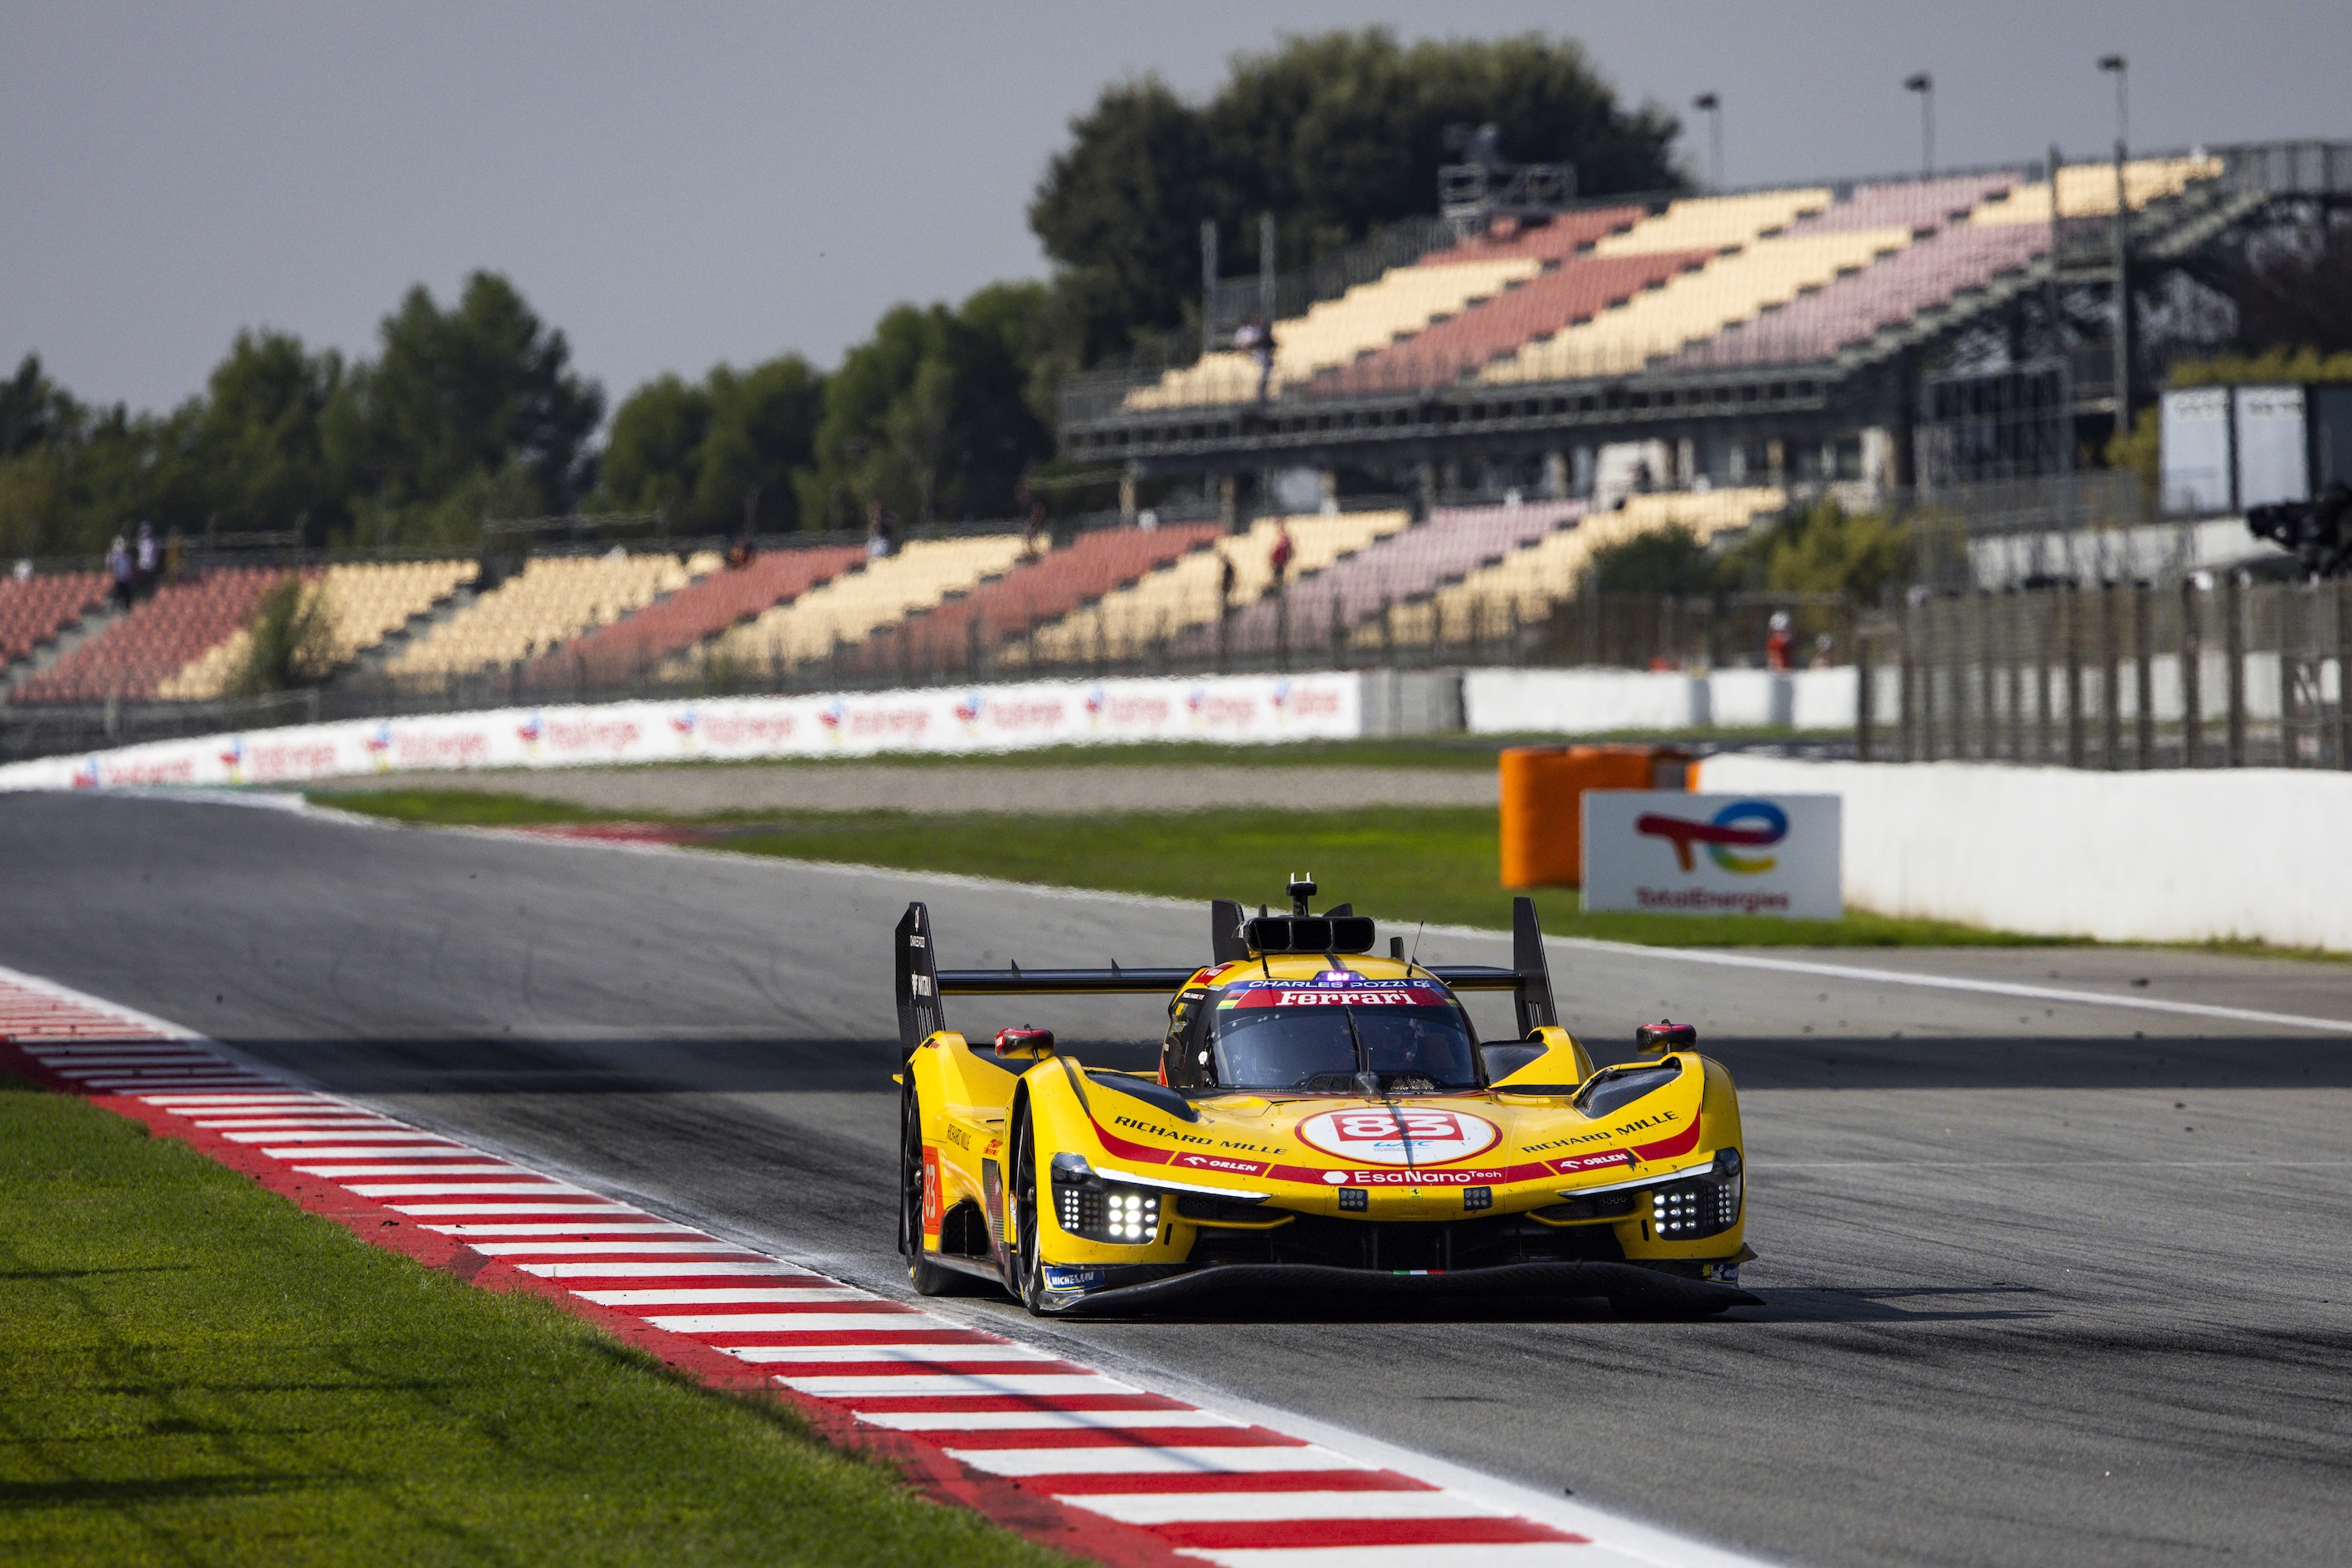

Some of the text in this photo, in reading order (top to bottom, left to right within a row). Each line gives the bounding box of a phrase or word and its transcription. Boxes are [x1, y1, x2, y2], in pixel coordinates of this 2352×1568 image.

[1248, 980, 1343, 988] CHARLES
[1275, 990, 1418, 1006] Ferrari
[1342, 1116, 1455, 1137] 83
[1522, 1110, 1679, 1153] RICHARD MILLE
[1114, 1115, 1288, 1156] RICHARD MILLE
[1210, 1160, 1259, 1172] ORLEN
[1583, 1152, 1629, 1166] ORLEN
[925, 1163, 936, 1219] 83
[1051, 1271, 1094, 1286] MICHELIN
